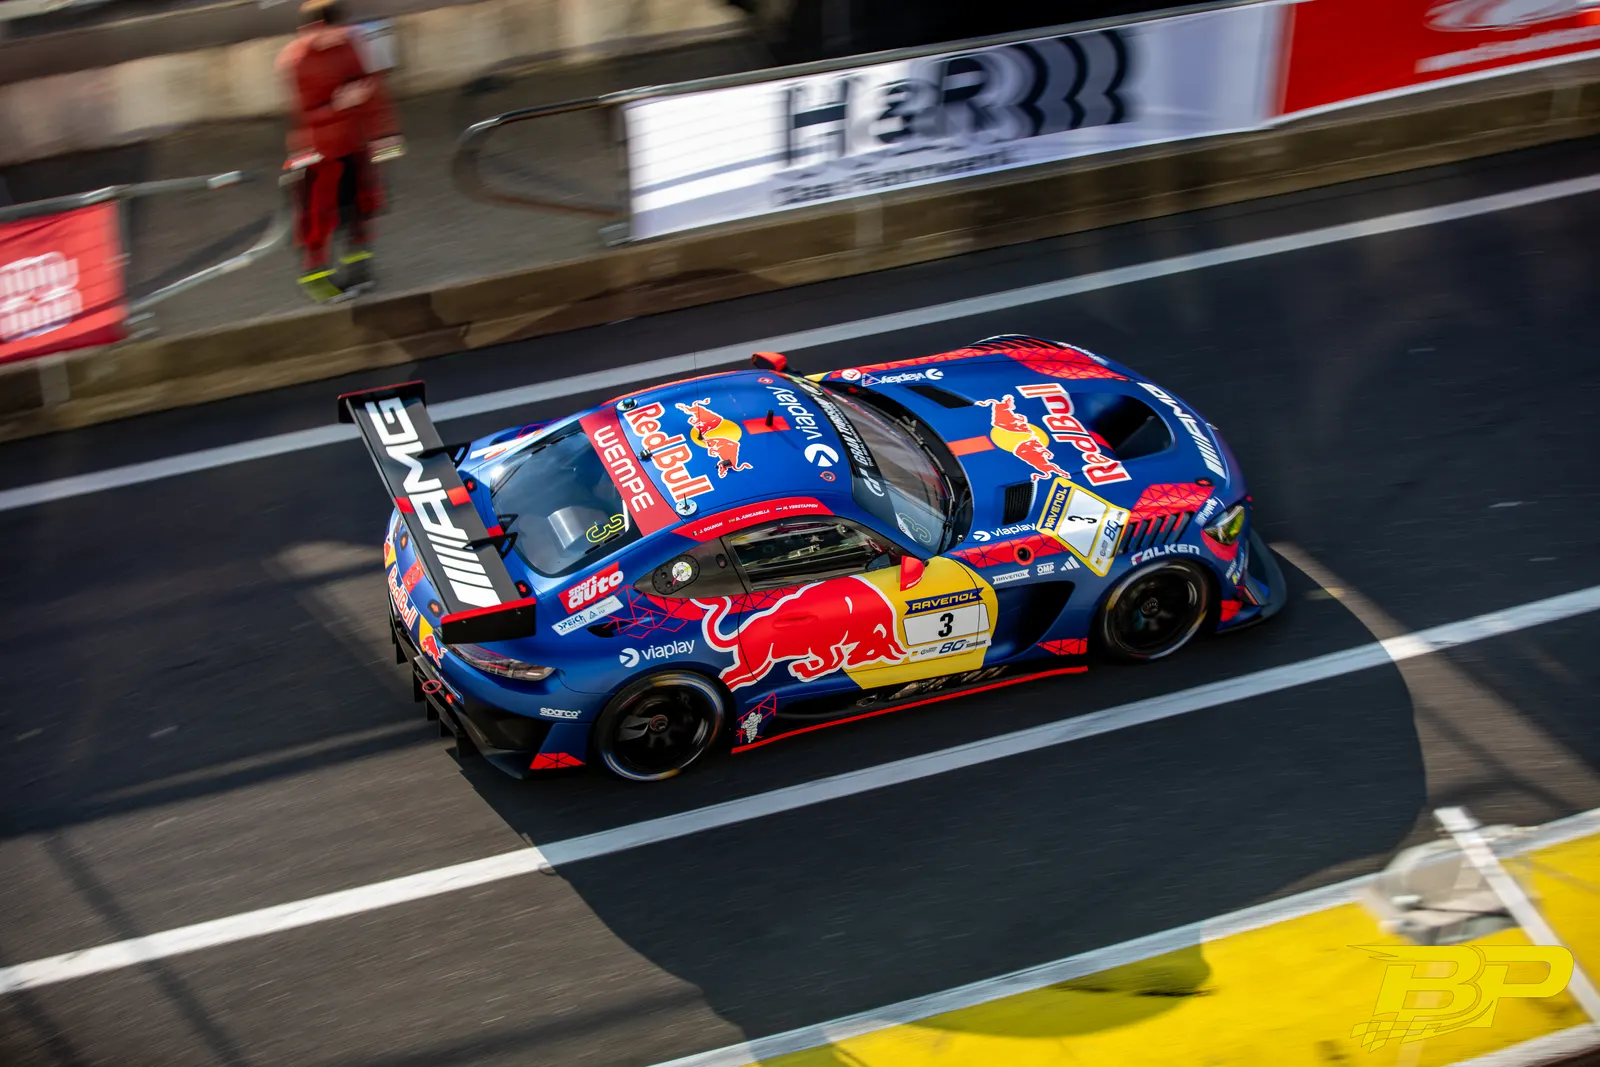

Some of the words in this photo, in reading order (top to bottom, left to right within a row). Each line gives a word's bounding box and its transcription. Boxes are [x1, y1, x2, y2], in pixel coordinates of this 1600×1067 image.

[880, 371, 926, 384] viaplay
[766, 386, 823, 440] viaplay
[594, 425, 654, 512] WEMPE
[1045, 488, 1067, 529] RAVENOL
[990, 522, 1036, 537] viaplay
[1068, 515, 1097, 524] 3
[1131, 543, 1200, 566] FALKEN
[995, 572, 1027, 582] RAVENOL
[1037, 563, 1055, 574] OMP
[568, 575, 598, 598] sport
[568, 571, 624, 609] auto
[912, 592, 977, 611] RAVENOL
[938, 612, 954, 638] 3
[641, 640, 695, 660] viaplay
[539, 707, 579, 719] sparco
